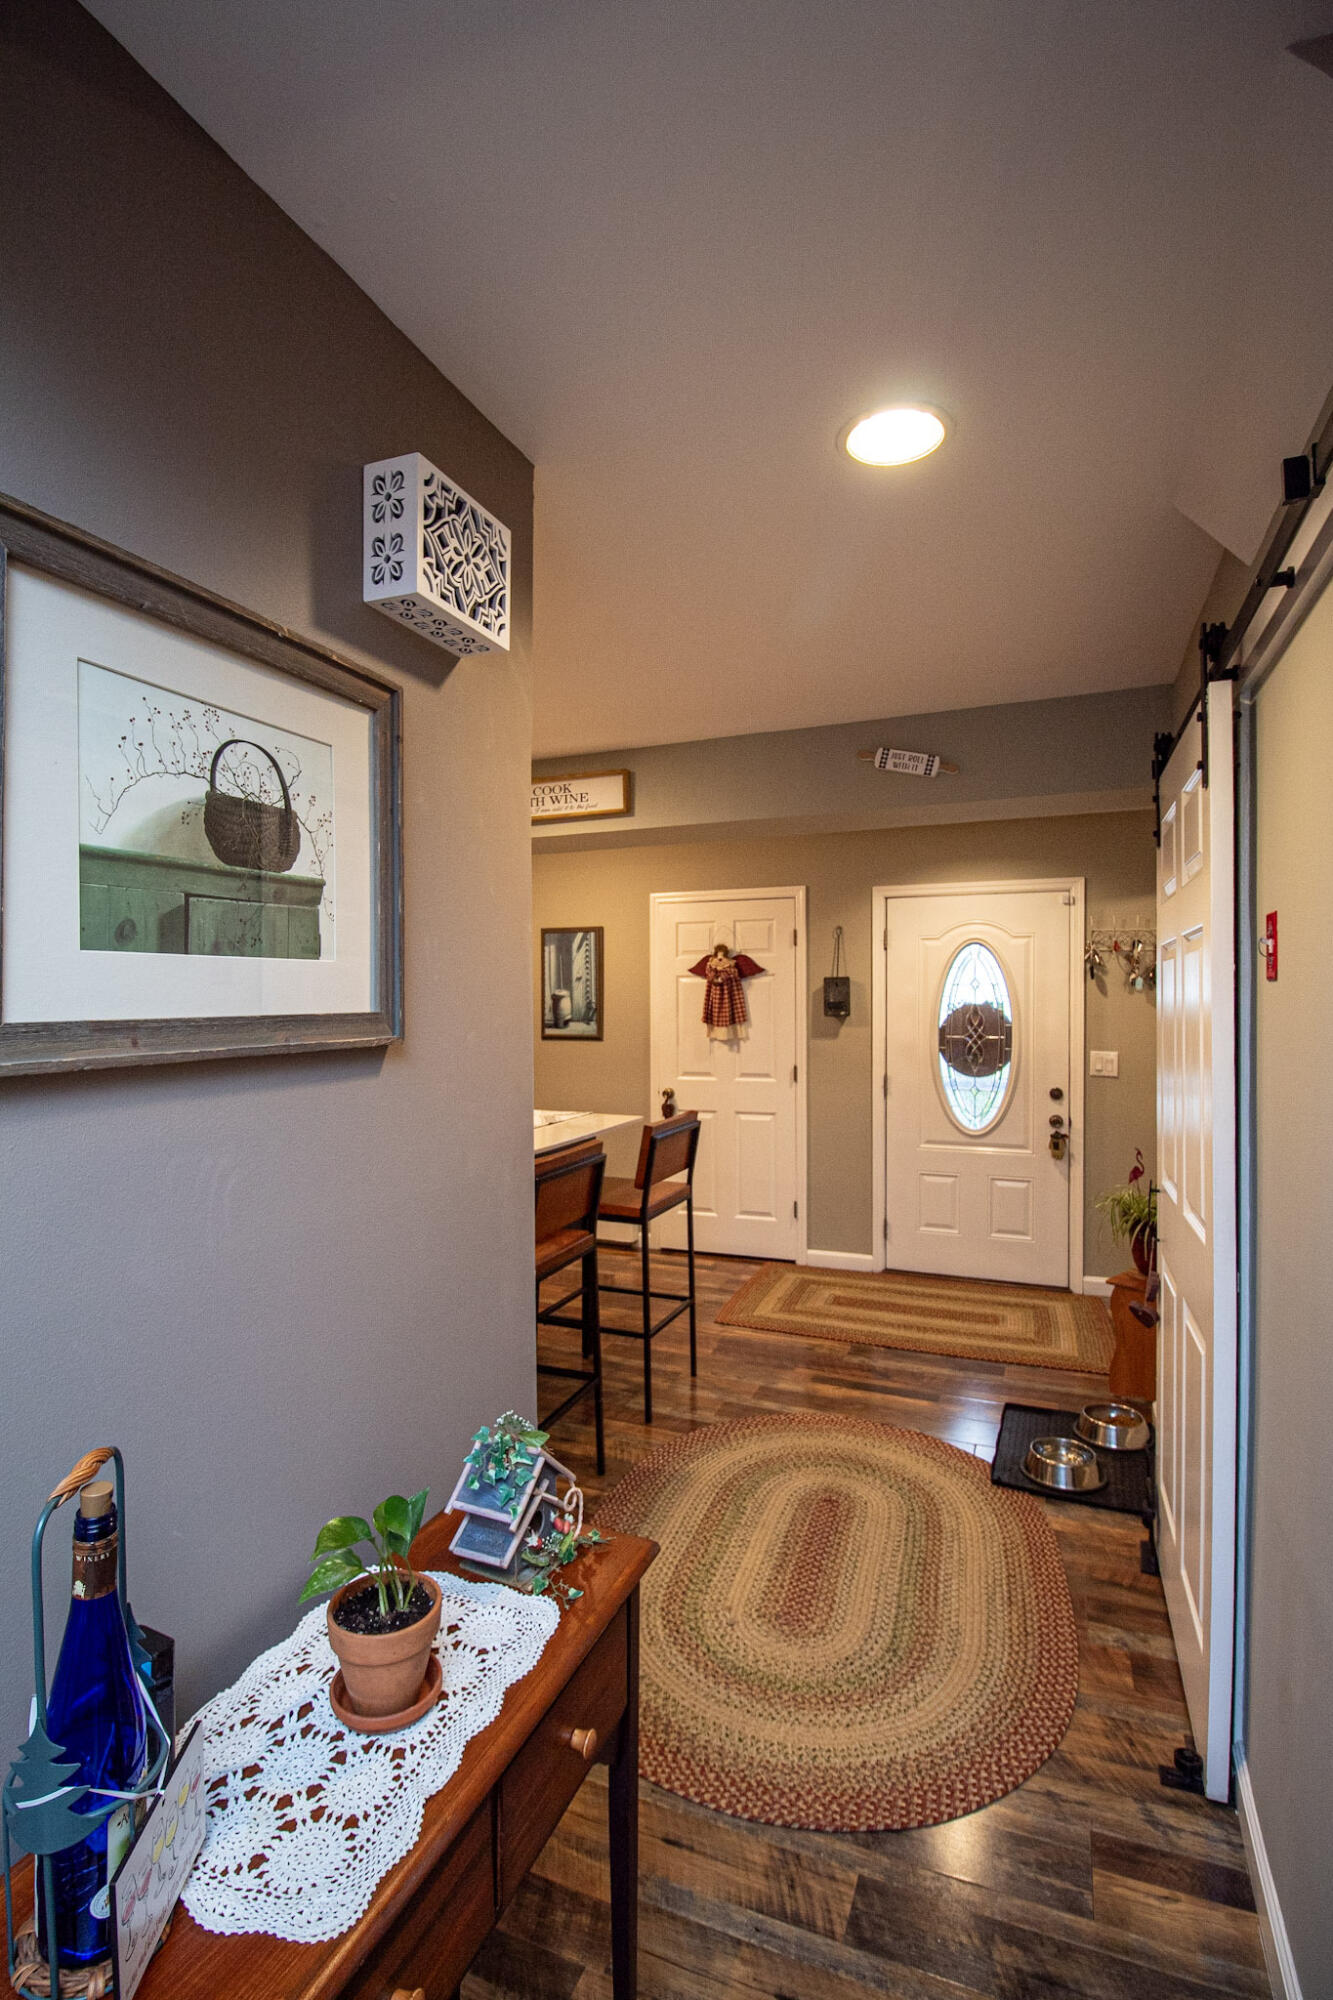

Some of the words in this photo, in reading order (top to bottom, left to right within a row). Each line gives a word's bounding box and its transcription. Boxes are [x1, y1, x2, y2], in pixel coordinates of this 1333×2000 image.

[891, 752, 906, 760] JUST
[908, 754, 924, 764] ROLL
[893, 762, 910, 770] WITH
[533, 783, 571, 796] COOK
[530, 796, 545, 807] TH
[550, 793, 588, 804] WINE
[75, 1552, 109, 1562] WINERY
